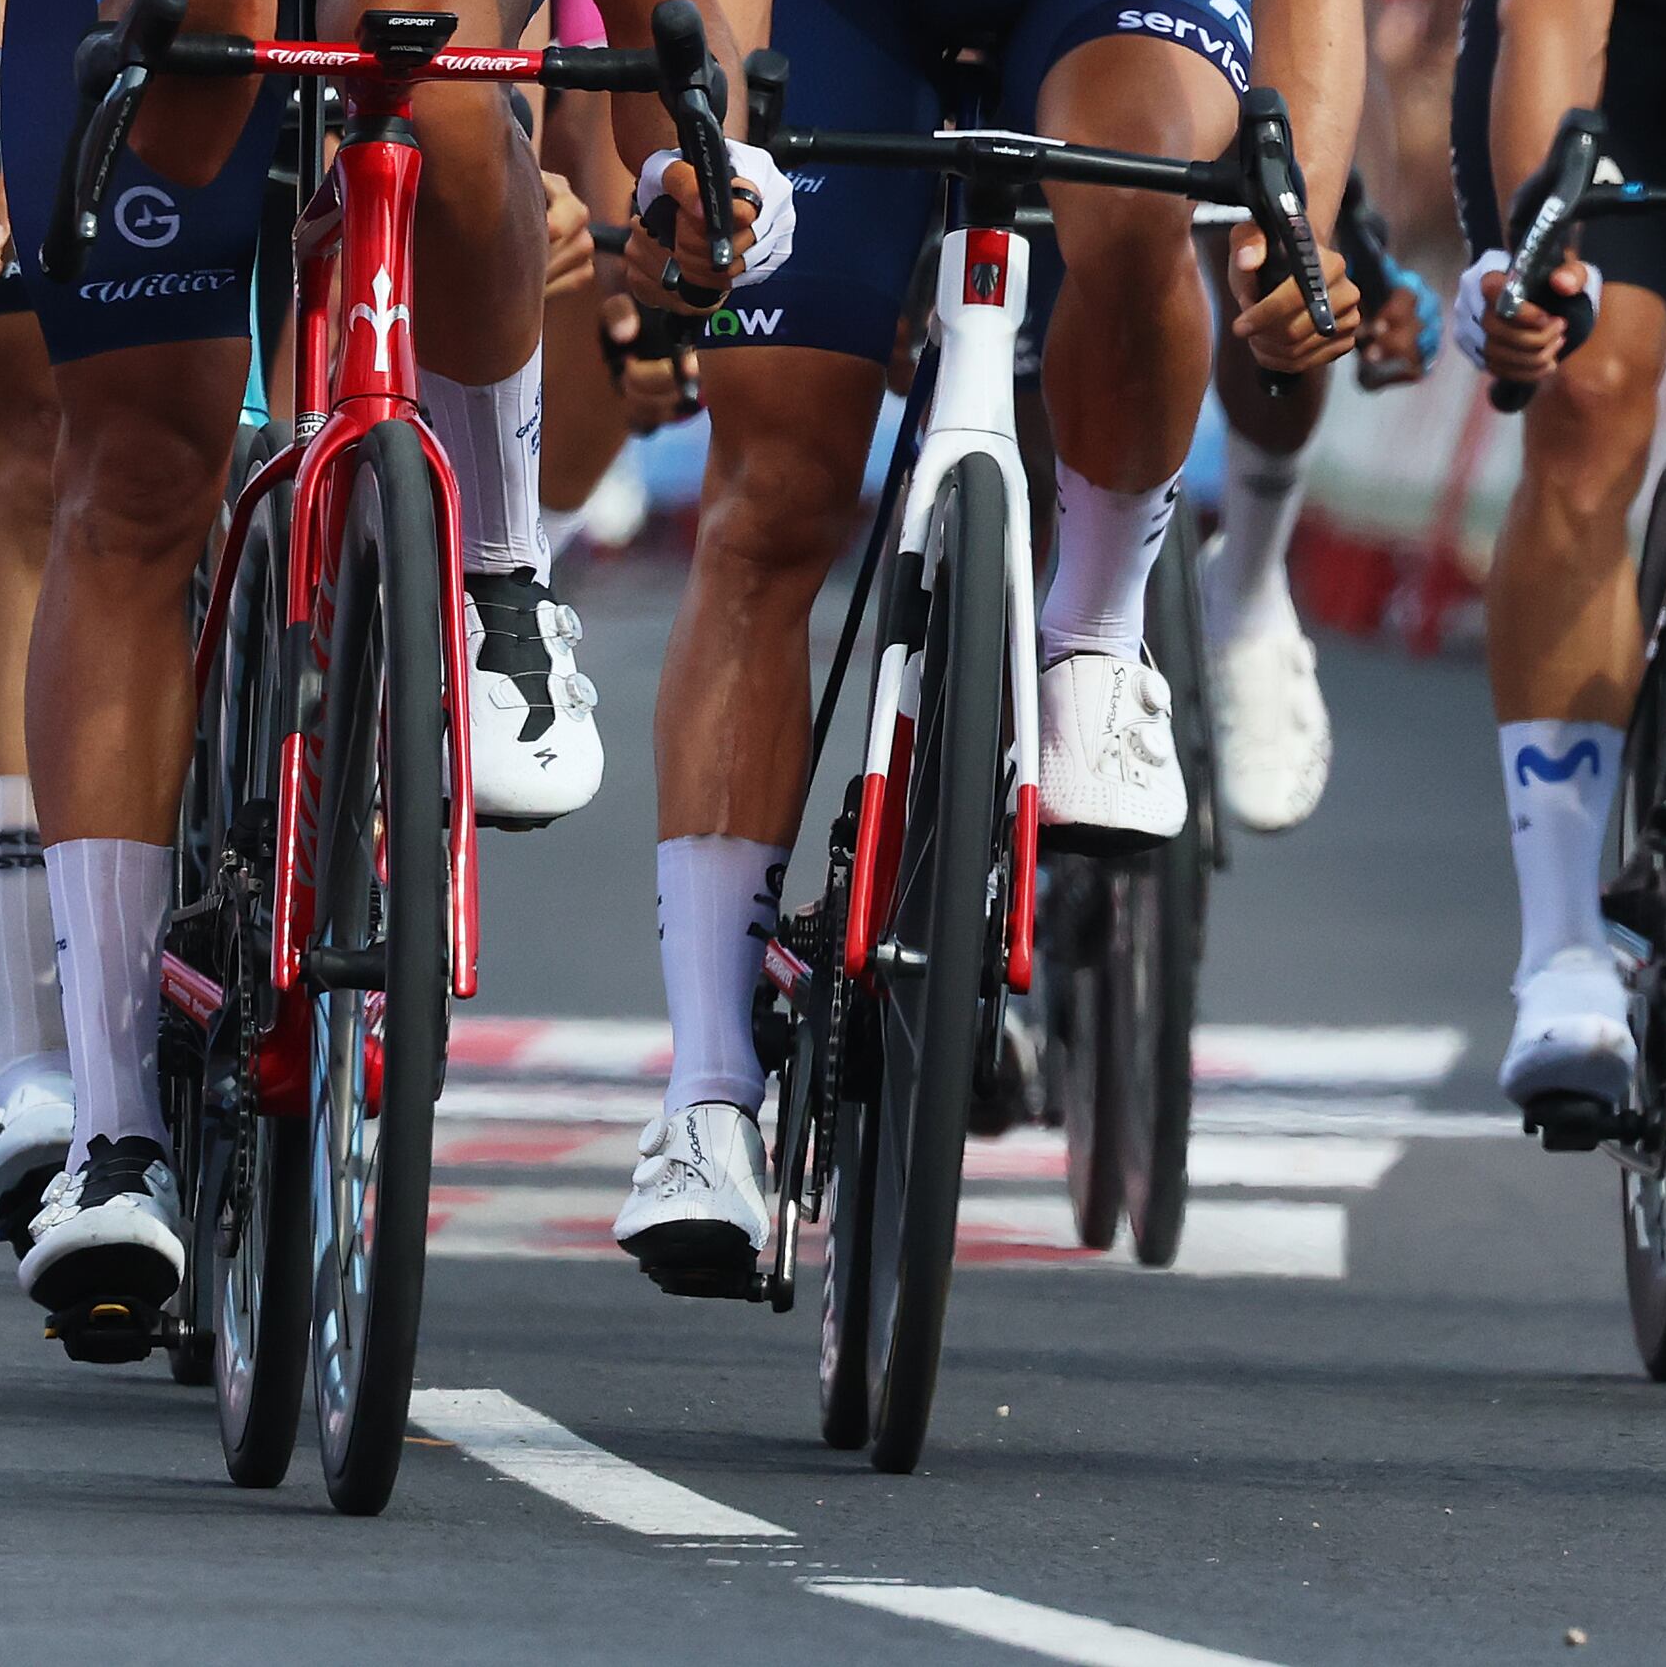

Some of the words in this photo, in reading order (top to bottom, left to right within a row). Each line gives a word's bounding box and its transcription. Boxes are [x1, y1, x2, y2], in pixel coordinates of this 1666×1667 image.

[266, 49, 361, 66] Wilier
[1117, 6, 1251, 94] servic
[436, 56, 529, 73] Wilier
[79, 272, 236, 304] Wilier
